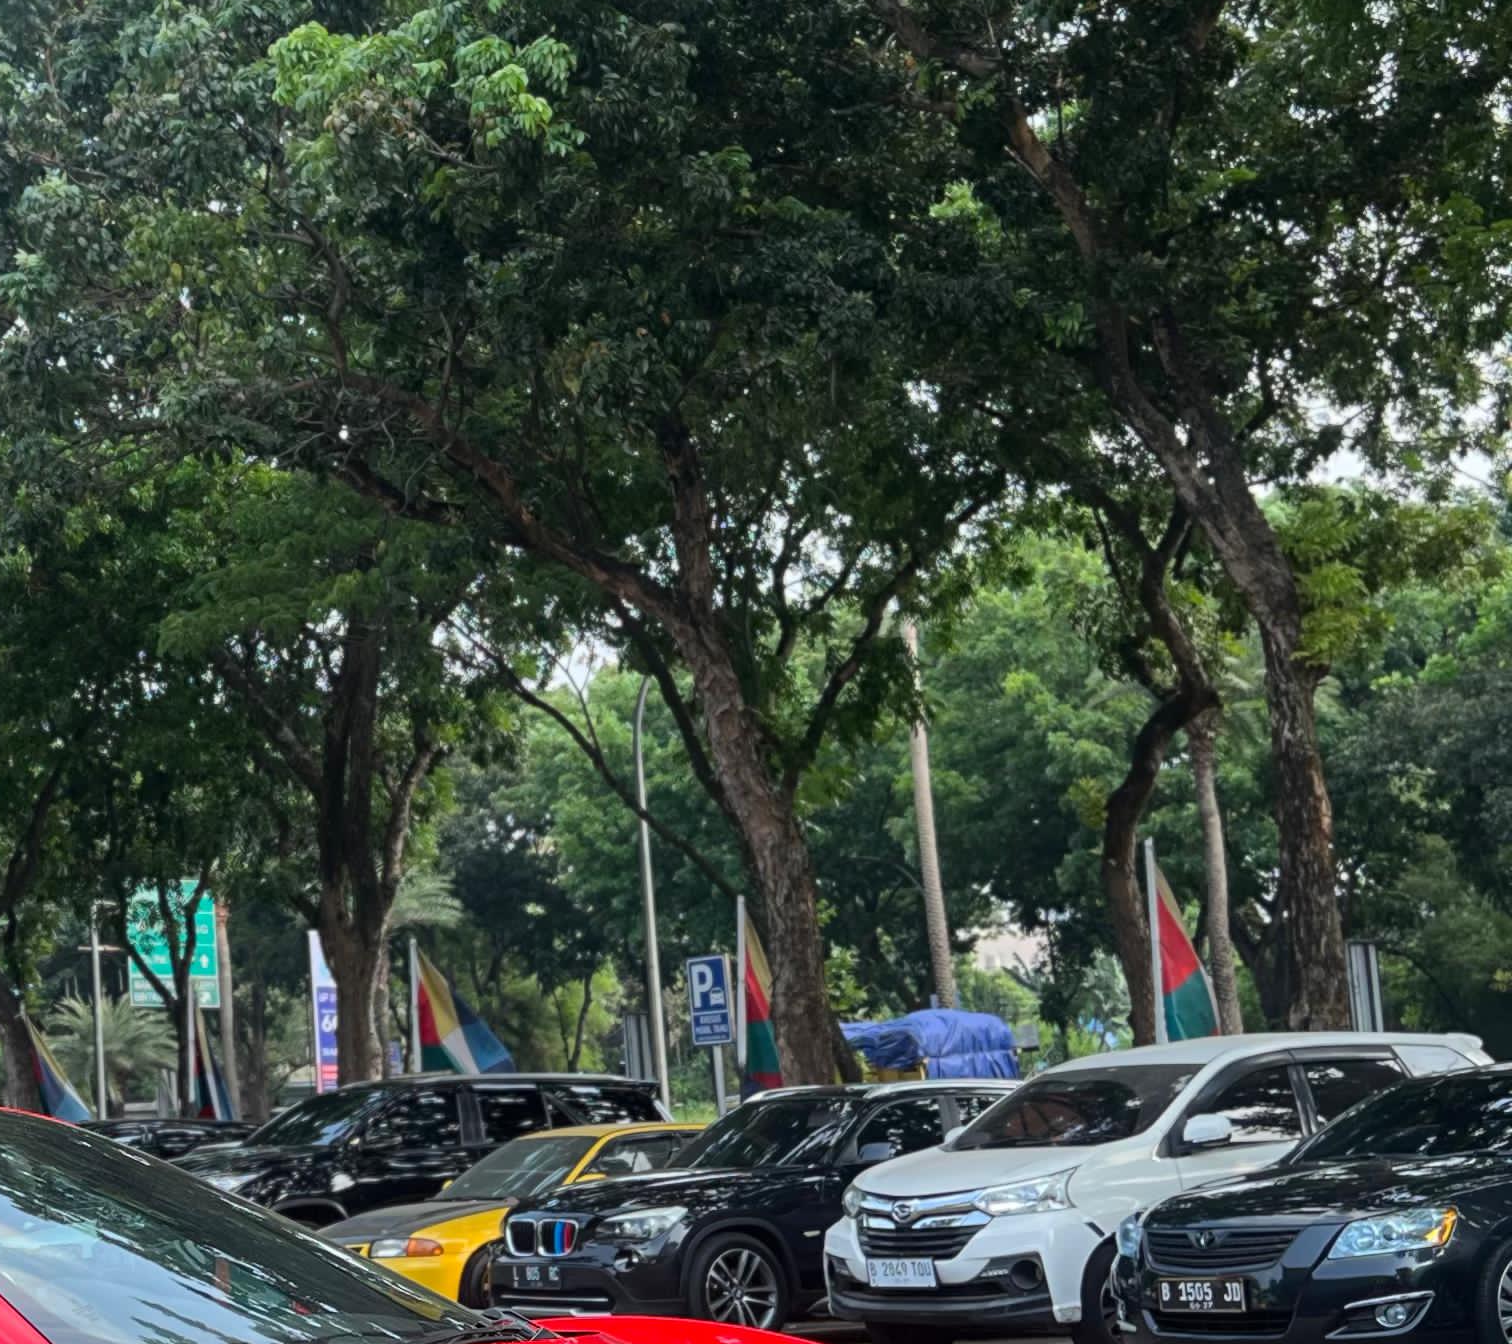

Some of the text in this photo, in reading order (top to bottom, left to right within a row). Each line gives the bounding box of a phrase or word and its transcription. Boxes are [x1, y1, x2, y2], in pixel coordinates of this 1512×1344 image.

[691, 964, 713, 1009] P
[1161, 1281, 1241, 1302] B 1505 JD
